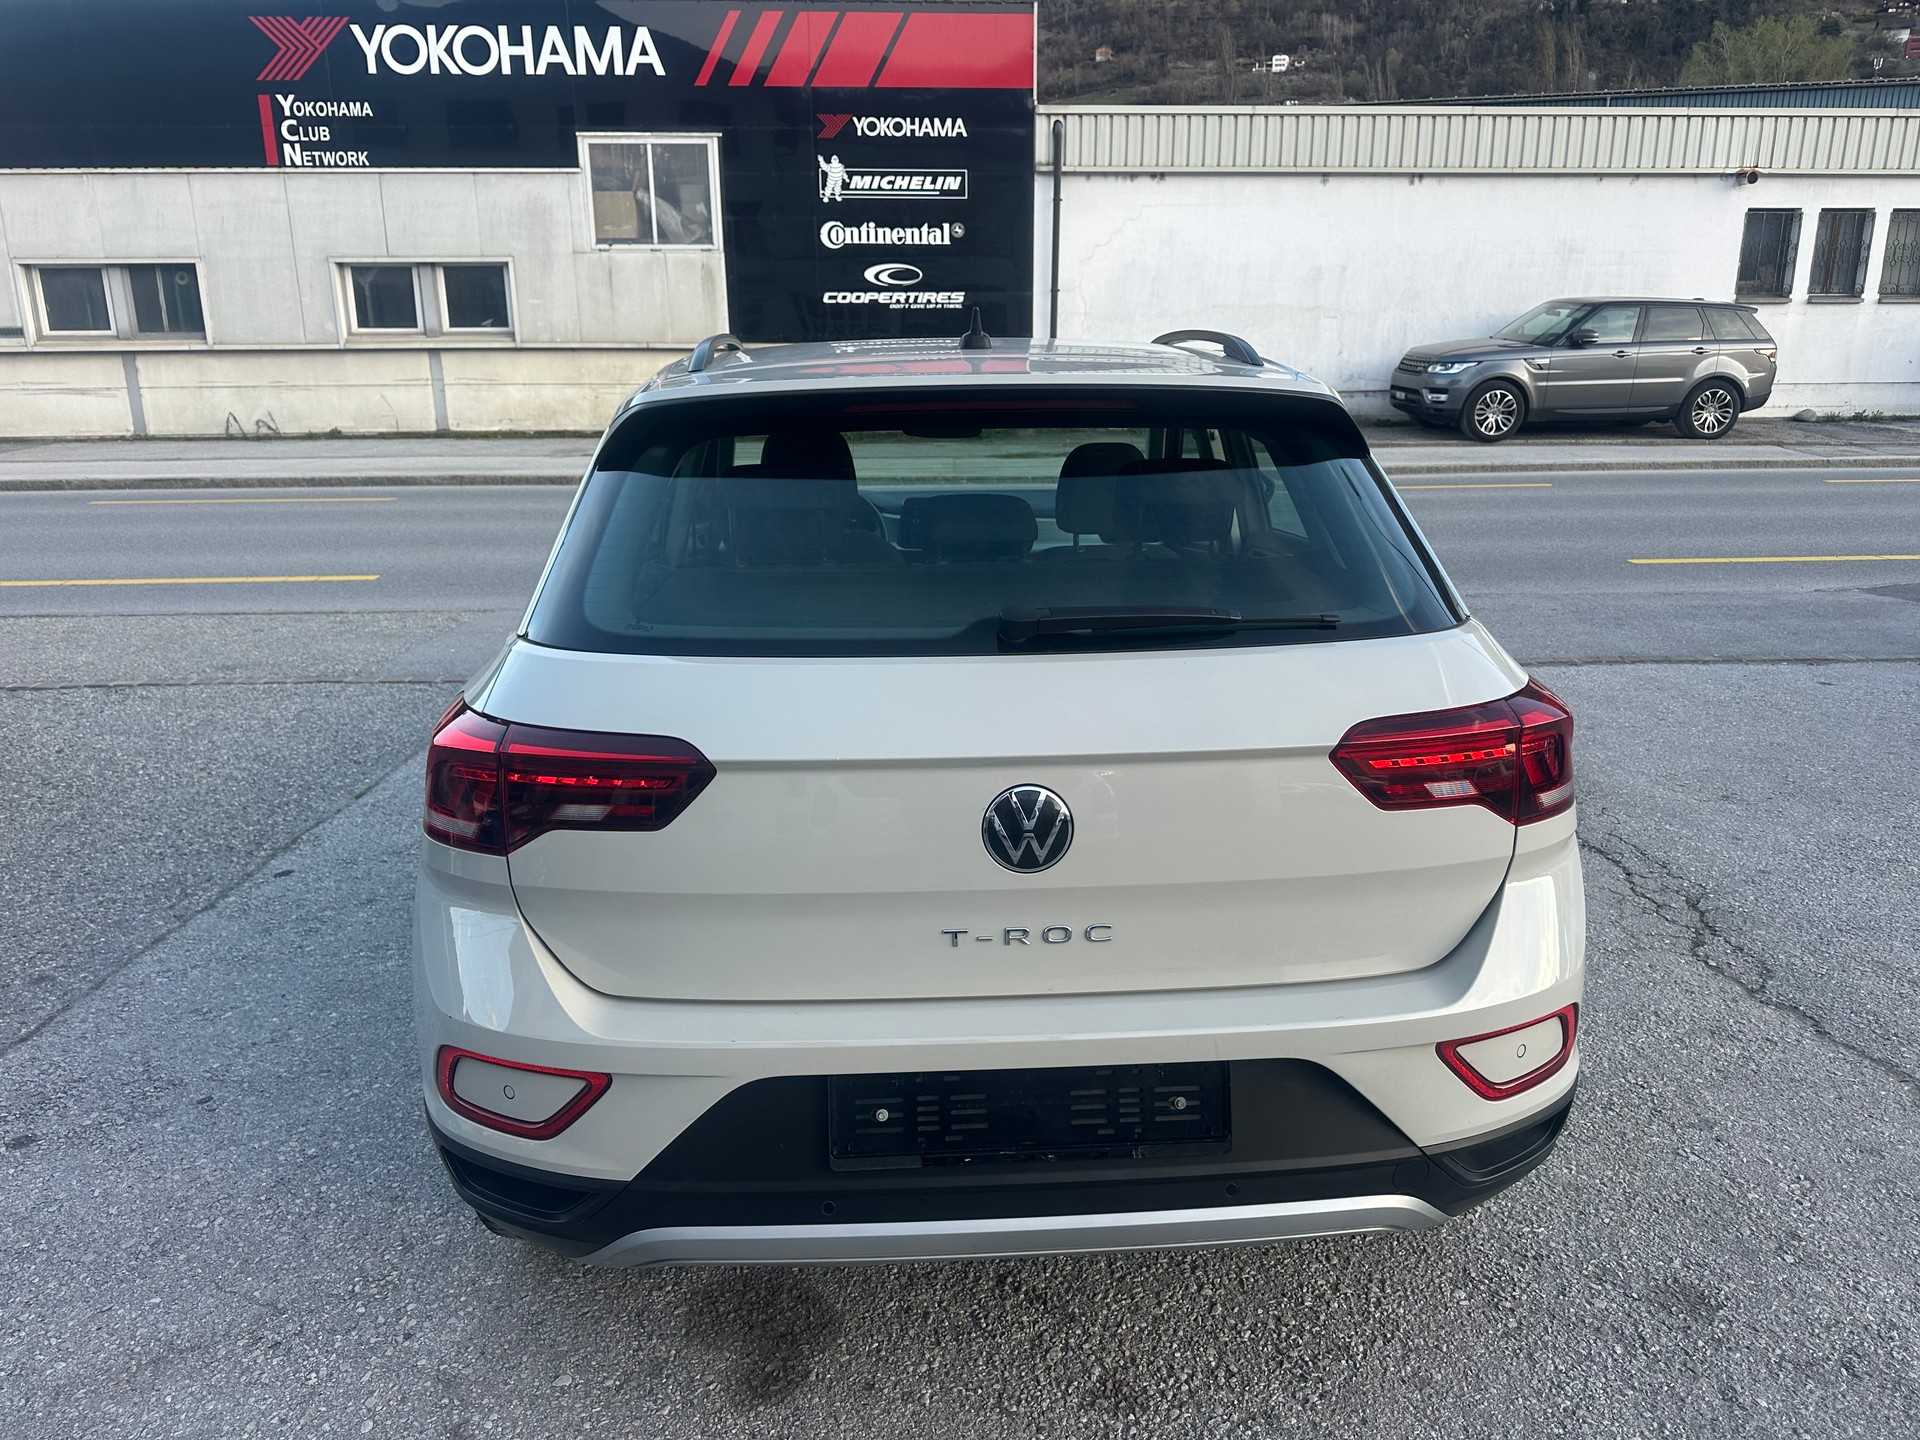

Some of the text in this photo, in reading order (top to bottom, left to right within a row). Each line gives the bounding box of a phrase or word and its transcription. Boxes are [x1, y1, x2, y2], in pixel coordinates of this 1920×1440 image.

[349, 24, 666, 76] YOKOHAMA
[275, 94, 373, 117] YOKOHAMA
[280, 119, 331, 142] CLUB
[852, 116, 968, 138] YOKOHAMA
[283, 143, 370, 166] NETWORK
[849, 175, 962, 190] MICHELIN
[820, 221, 951, 249] Continental
[941, 923, 1113, 948] T-ROC
